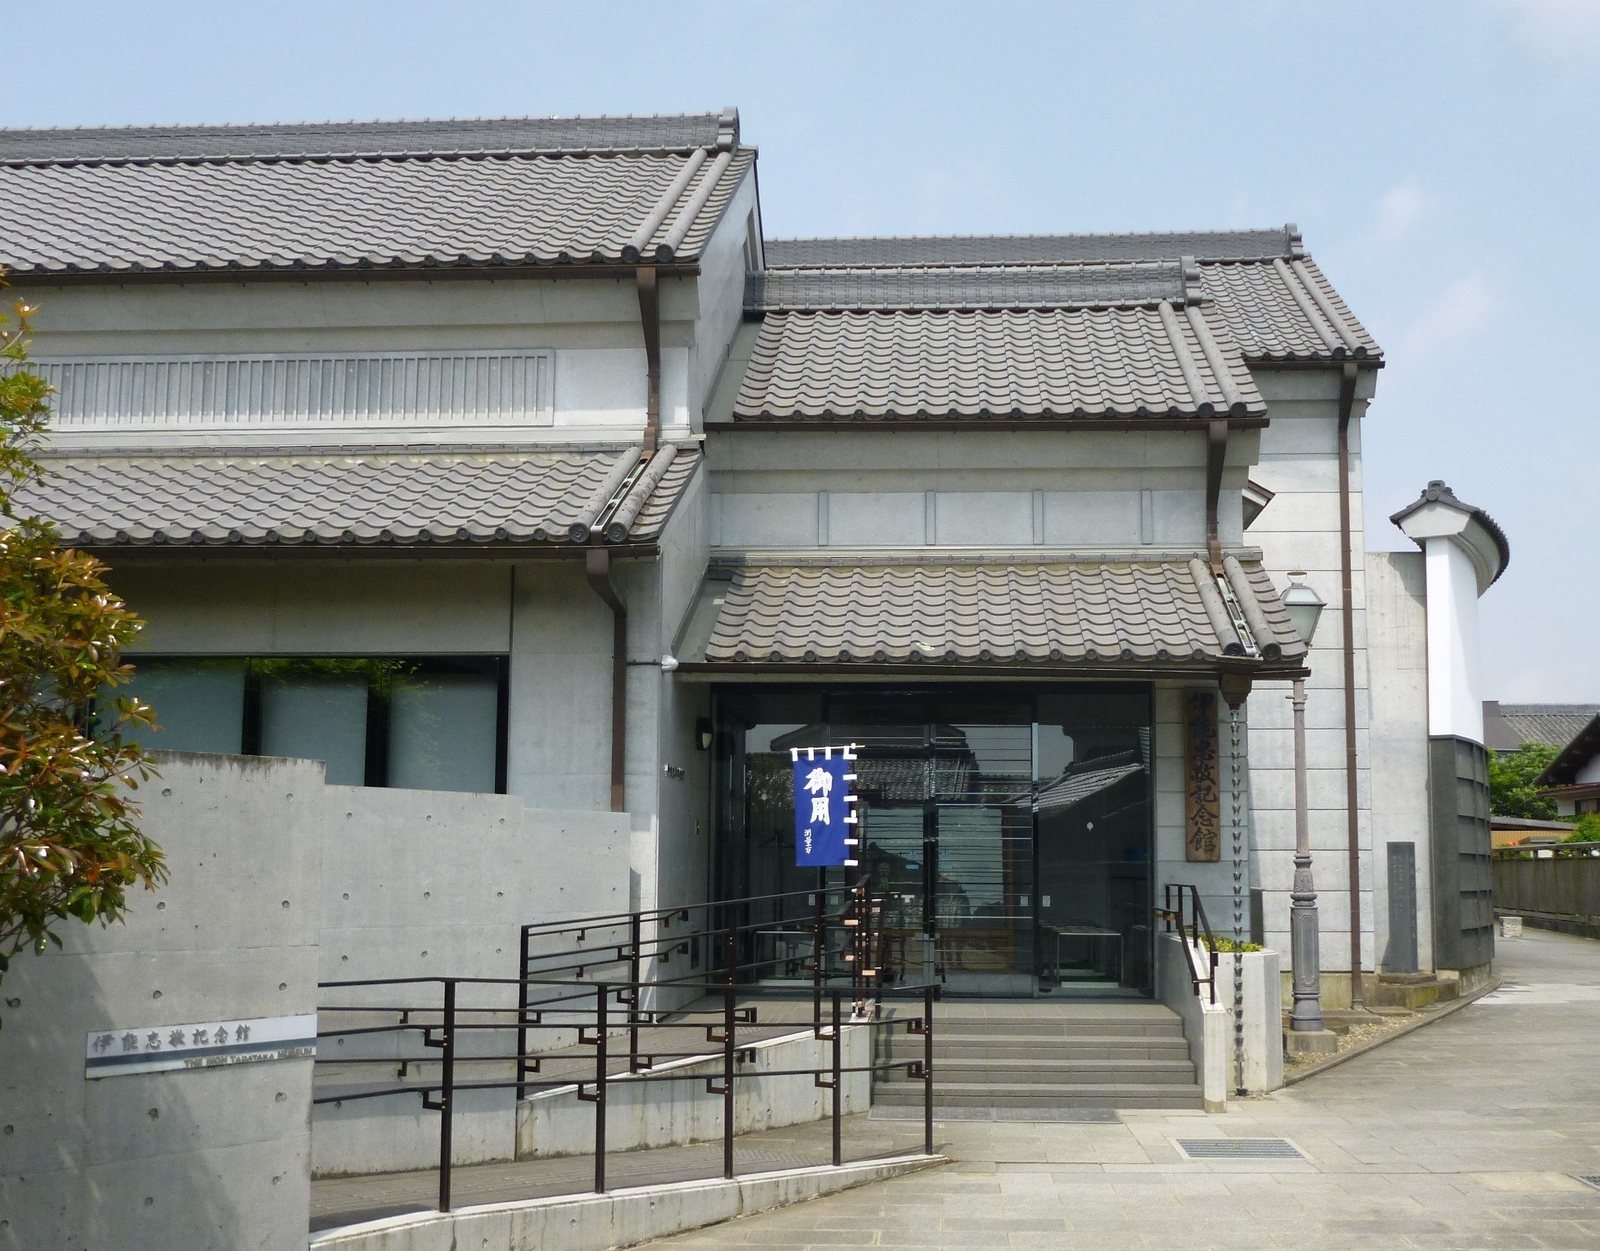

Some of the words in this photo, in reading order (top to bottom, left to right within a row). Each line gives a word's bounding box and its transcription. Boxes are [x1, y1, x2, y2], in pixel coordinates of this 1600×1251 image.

[803, 767, 833, 826] 御用
[92, 1023, 251, 1052] 伊能忠敬記念館
